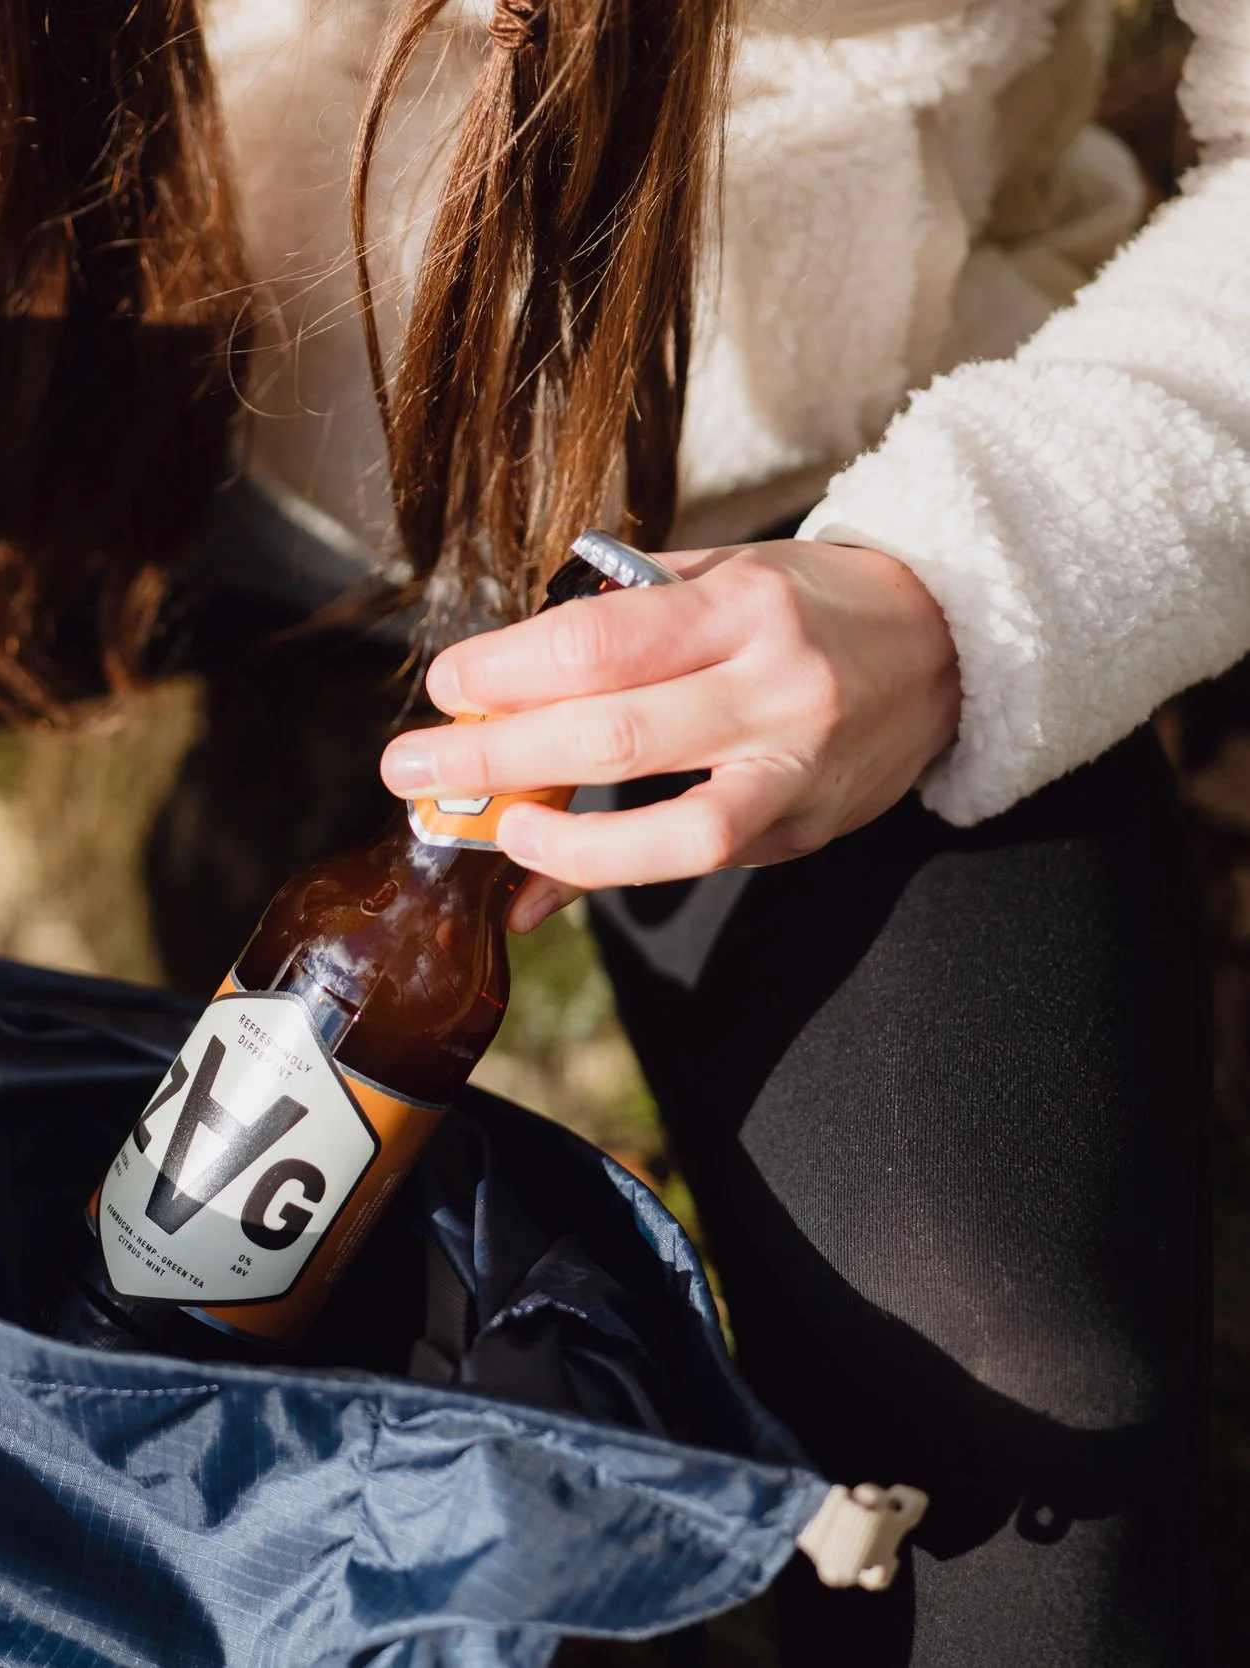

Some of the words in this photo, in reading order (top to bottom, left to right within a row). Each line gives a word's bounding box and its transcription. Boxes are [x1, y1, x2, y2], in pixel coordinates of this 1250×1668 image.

[107, 1203, 134, 1237] KOMBUCHA
[136, 1236, 157, 1255] HEMP
[161, 1256, 188, 1278] GREEN
[188, 1274, 204, 1289] TEA
[117, 1234, 141, 1259] CITRUS
[145, 1258, 166, 1277] MINT
[238, 1254, 253, 1266] 0%
[229, 1264, 249, 1278] ABV
